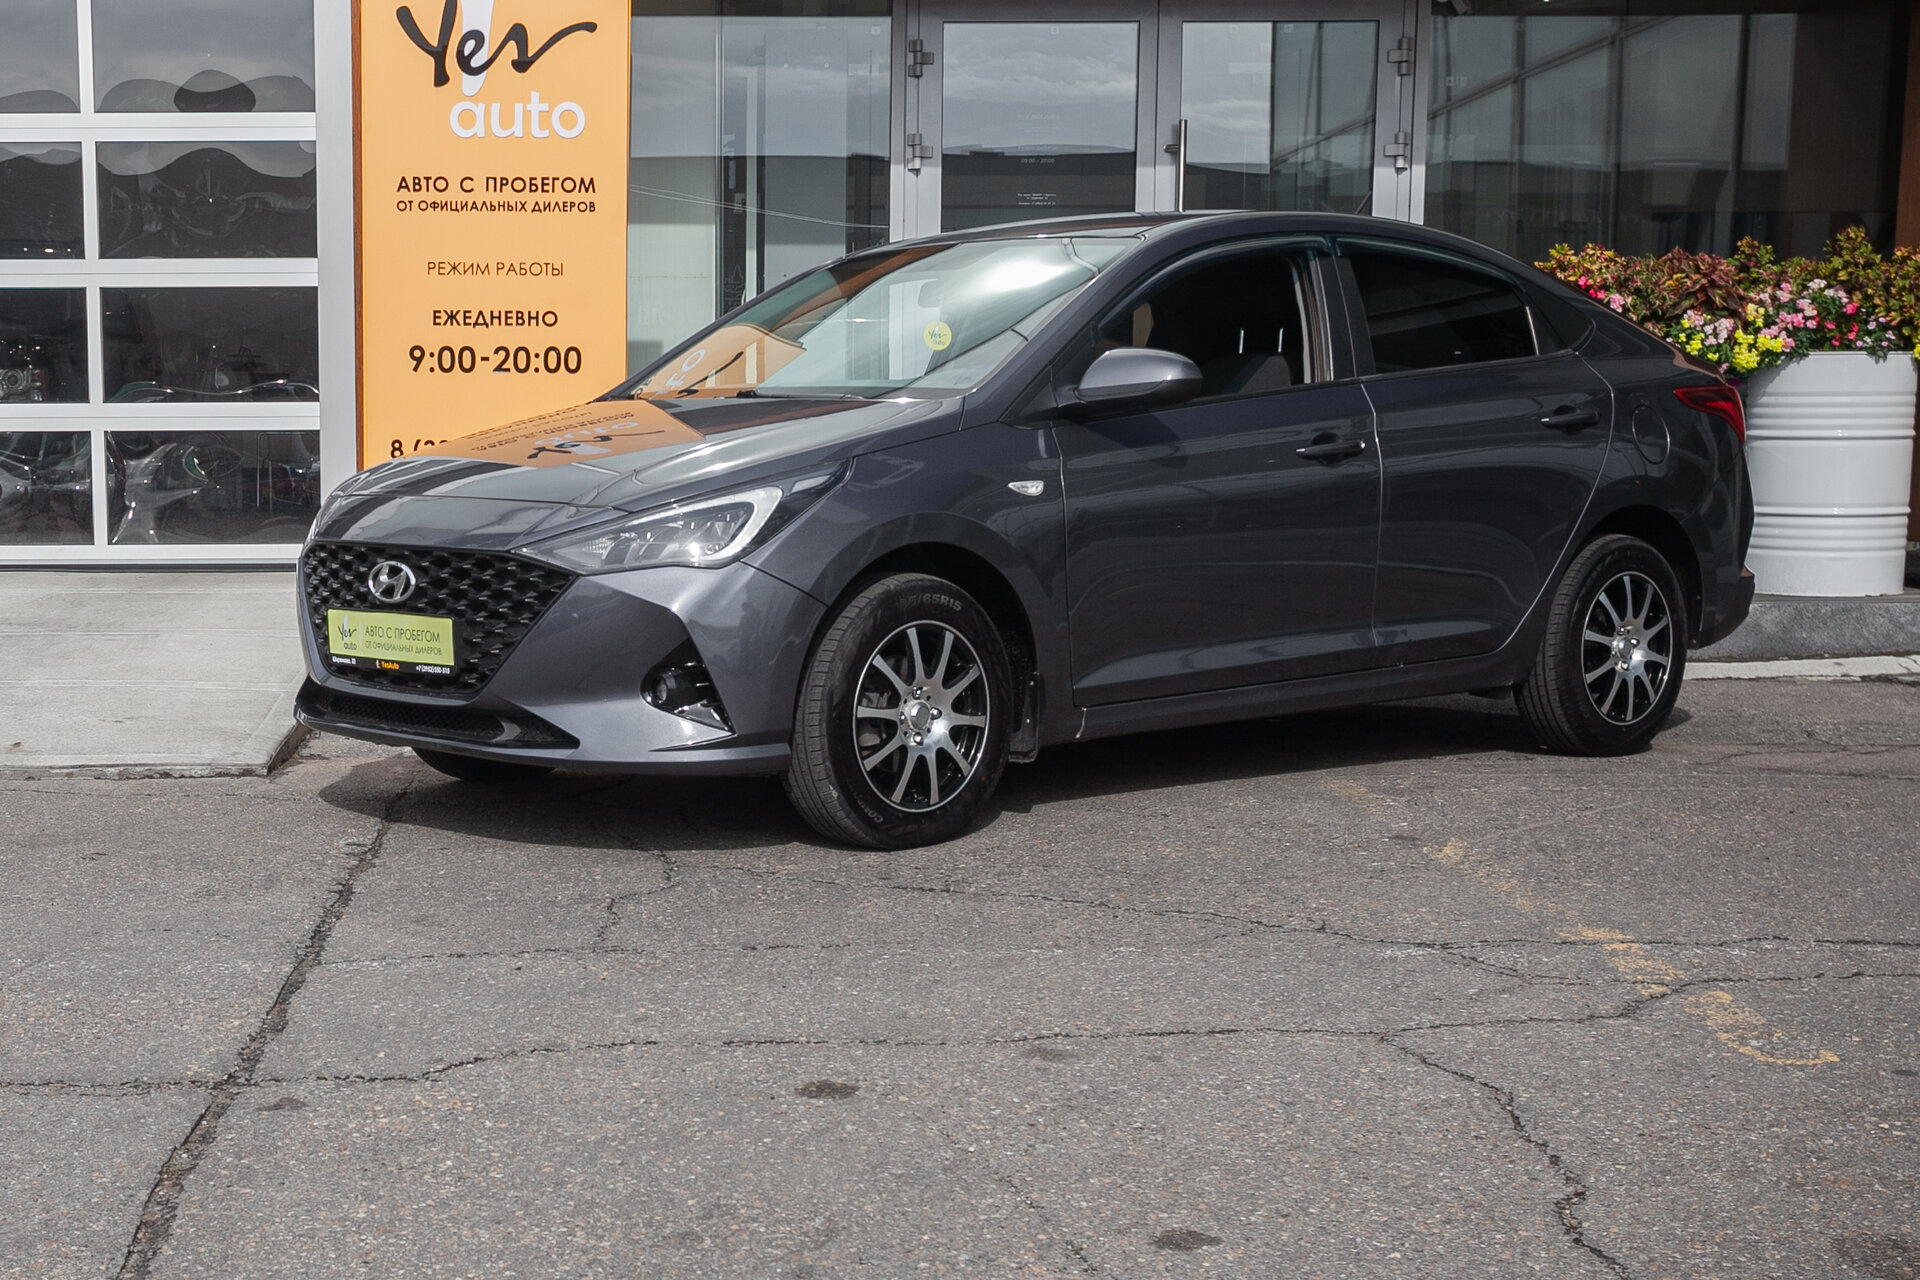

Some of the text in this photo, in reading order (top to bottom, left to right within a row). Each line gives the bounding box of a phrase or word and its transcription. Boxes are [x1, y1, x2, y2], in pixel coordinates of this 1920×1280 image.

[396, 0, 597, 88] Yes
[450, 91, 586, 139] auto
[396, 176, 596, 194] АВТО С ПРОБЕГОМ
[396, 200, 596, 213] ОТ ОФИЦИАЛЬНЫХ ДИЛЕРОВ
[427, 261, 563, 277] РЕЖИМ РАБОТЫ
[432, 310, 559, 328] ЕЖЕДНЕВНО
[408, 345, 582, 374] 9:00-20:00
[364, 626, 441, 643] АВТО С ПРОБЕГОМ
[343, 642, 358, 650] auto
[364, 640, 442, 656] ОТ ОФИЦИАЛЬНЫХ ДИЛЕРОВ
